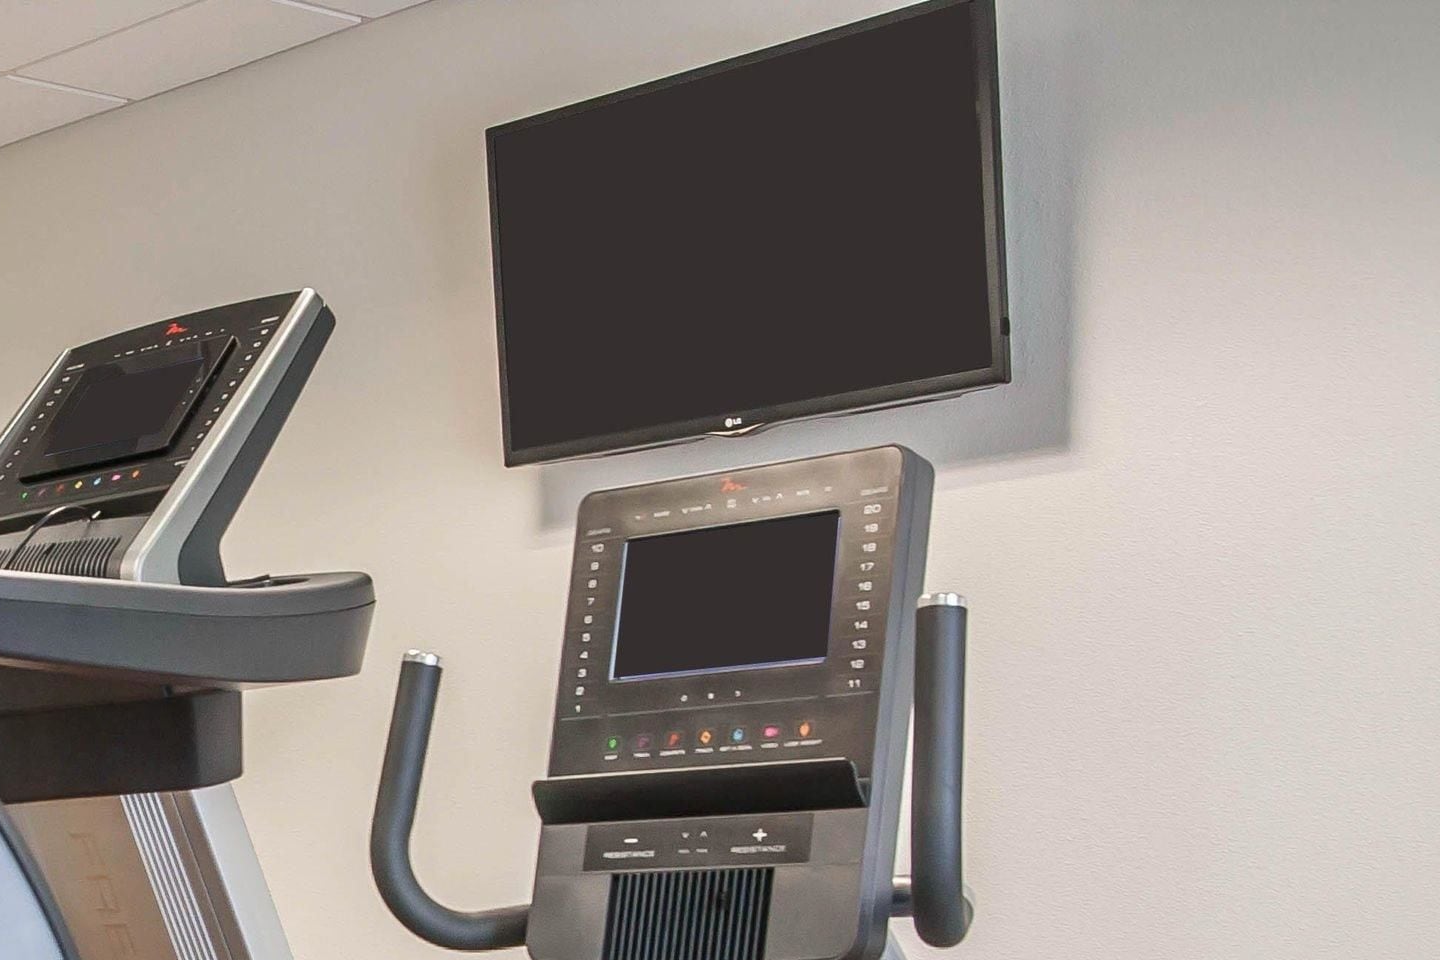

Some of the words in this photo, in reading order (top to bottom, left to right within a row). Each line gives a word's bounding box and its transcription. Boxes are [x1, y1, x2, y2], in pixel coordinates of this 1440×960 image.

[860, 562, 875, 571] 17
[854, 620, 869, 630] 14
[579, 651, 589, 659] 4
[577, 668, 587, 678] 3
[848, 679, 861, 688] 11
